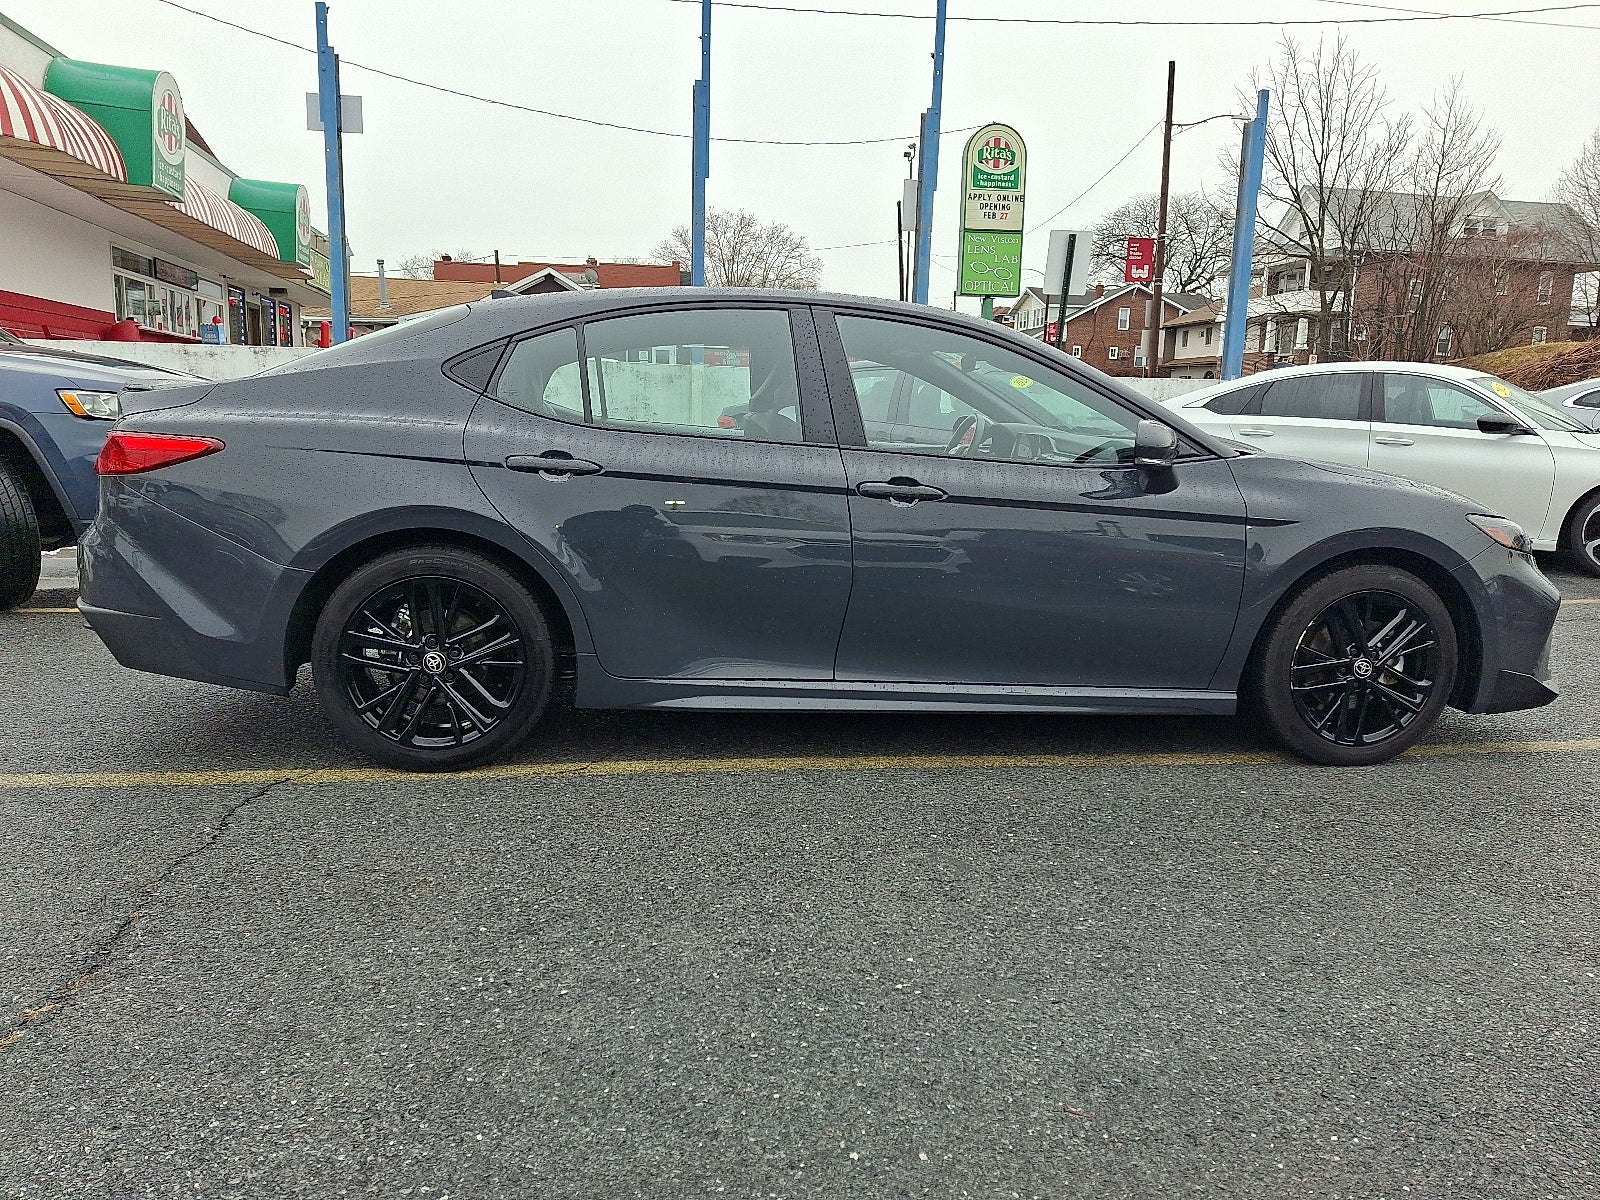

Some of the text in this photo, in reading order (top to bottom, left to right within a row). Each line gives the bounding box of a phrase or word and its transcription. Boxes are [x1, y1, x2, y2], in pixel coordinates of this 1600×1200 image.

[983, 146, 1012, 160] Rita's
[967, 192, 1025, 203] APPLY ONLINE
[979, 202, 1011, 211] OPENING
[983, 211, 1009, 220] FEB 27
[967, 245, 996, 254] LENS
[994, 254, 1019, 264] LAB
[964, 280, 1017, 292] OPTICAL
